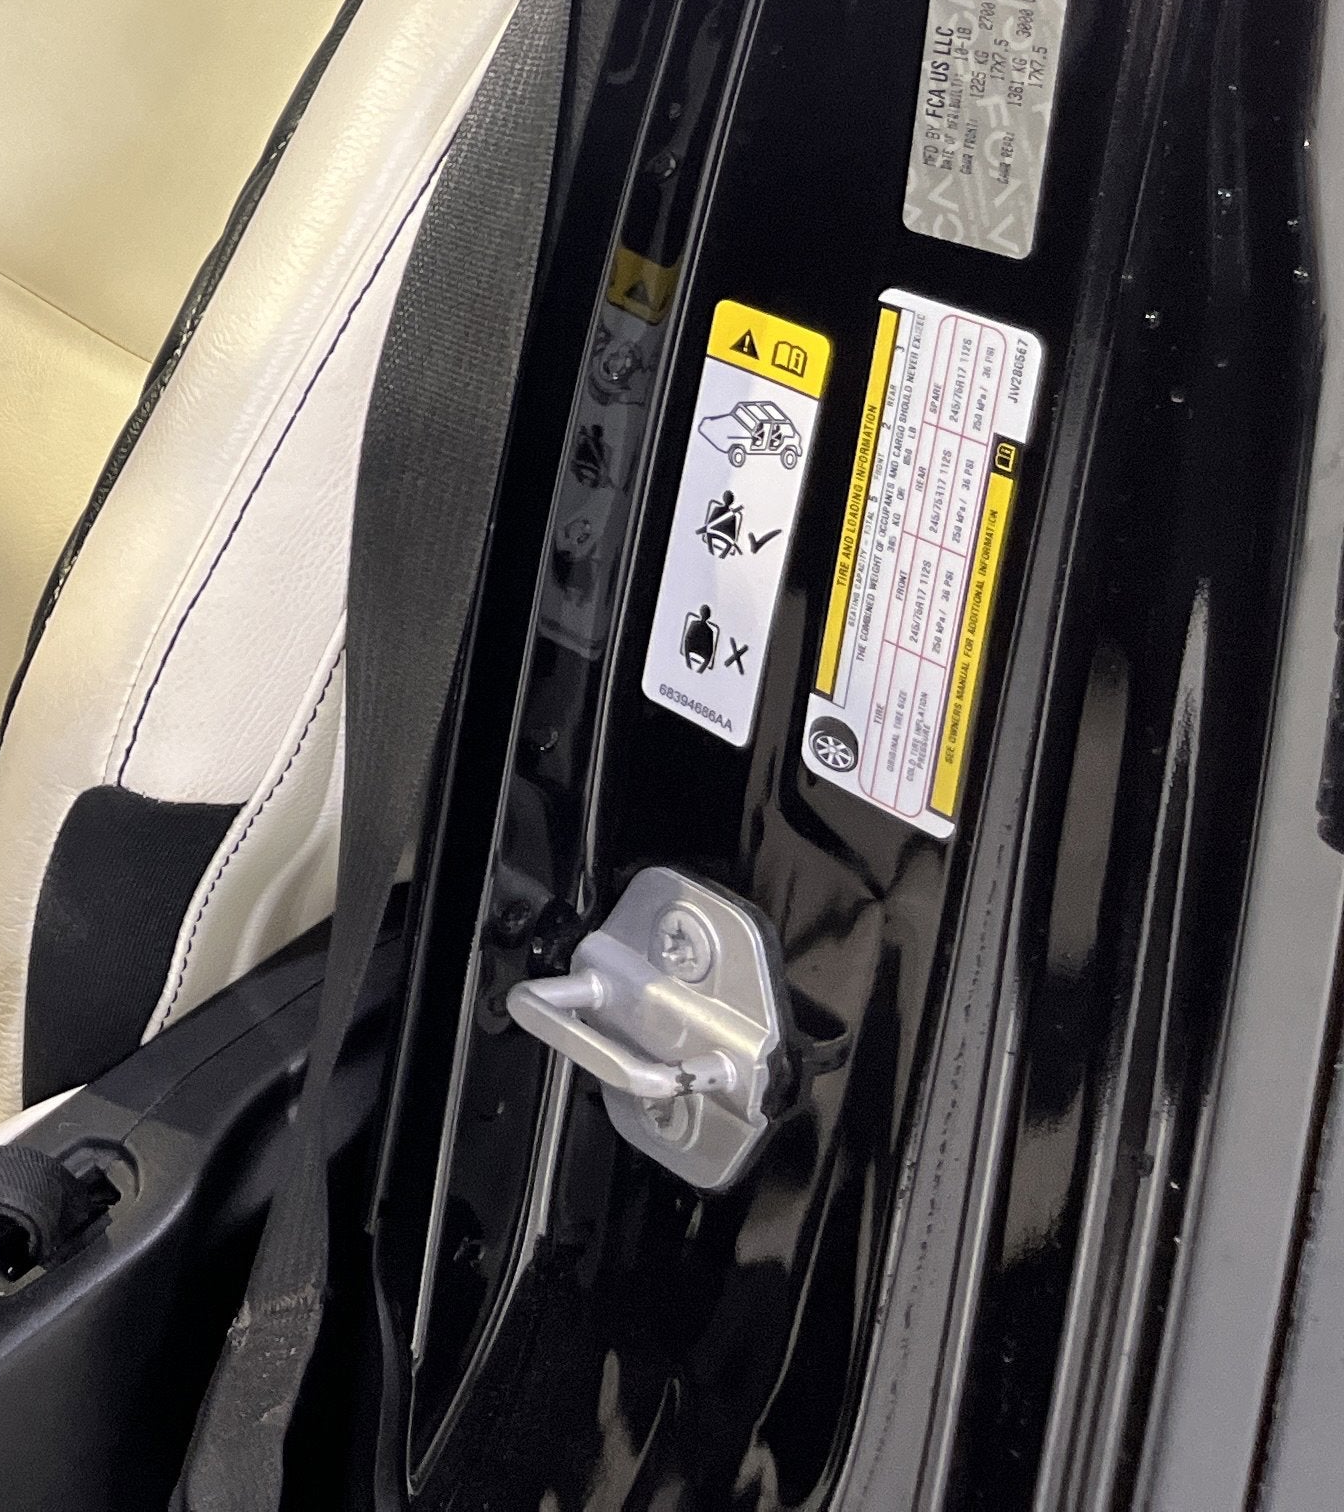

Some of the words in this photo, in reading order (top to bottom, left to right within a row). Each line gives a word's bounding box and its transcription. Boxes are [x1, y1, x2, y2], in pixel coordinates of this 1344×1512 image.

[978, 0, 996, 31] 2700
[1016, 7, 1034, 38] 3000
[933, 24, 954, 56] LLC
[930, 58, 950, 83] US
[974, 49, 989, 65] KG
[989, 37, 1009, 81] 17X7.5
[1012, 55, 1027, 73] KG
[1028, 44, 1048, 89] 17X7.5
[969, 69, 986, 99] 1225
[1007, 78, 1024, 107] 1361
[925, 85, 946, 119] FCA
[926, 123, 940, 139] BY
[944, 132, 956, 145] OF
[923, 143, 938, 167] MFD
[941, 148, 954, 171] DATE
[895, 344, 905, 353] 3
[960, 337, 972, 363] 112S
[985, 345, 995, 364] PSI
[907, 351, 919, 383] NEVER
[982, 364, 992, 378] 36
[1007, 337, 1029, 404] JW280567
[887, 383, 896, 408] REAR
[899, 384, 913, 424] SHOULD
[949, 365, 967, 423] 245/75R17
[881, 421, 891, 430] 2
[973, 412, 983, 431] 250
[855, 402, 877, 482] INFORMATION
[893, 424, 905, 458] CARGO
[875, 452, 885, 481] FRONT
[889, 459, 899, 480] AND
[940, 447, 952, 475] 112S
[964, 458, 974, 476] PSI
[892, 512, 901, 527] KG
[897, 486, 905, 501] OR
[908, 425, 916, 439] LB
[961, 476, 971, 491] 36
[846, 482, 863, 533] LOADING
[868, 492, 878, 503] 5
[879, 481, 895, 538] OCCUPANTS
[929, 477, 946, 534] 245/75R17
[865, 509, 875, 536] TOTAL
[952, 524, 962, 544] 250
[841, 534, 854, 560] AND
[874, 702, 884, 725] TIRE
[895, 568, 908, 602] FRONT
[915, 465, 926, 492] REAR
[929, 381, 941, 414] SPARE
[876, 538, 885, 553] OF
[978, 507, 998, 577] INFORMATION
[837, 560, 849, 589] TIRE
[855, 549, 867, 590] CAPACITY
[869, 553, 882, 591] WEIGHT
[920, 558, 932, 586] 112S
[944, 569, 954, 588] PSI
[849, 590, 860, 628] SEATING
[860, 592, 875, 642] COMBINED
[910, 587, 927, 644] 245/75R17
[968, 577, 985, 636] ADDITIONAL
[857, 642, 866, 663] THE
[932, 634, 942, 654] 250
[963, 636, 974, 659] FOR
[956, 659, 970, 702] MANUAL
[659, 683, 732, 732] 68394686AA
[897, 688, 907, 710] SIZE
[914, 690, 929, 737] INFLATION
[894, 709, 904, 731] TIRE
[948, 701, 962, 744] OWNERS
[887, 731, 900, 773] ORIGINAL
[911, 736, 921, 757] TIRE
[916, 722, 931, 770] PRESSURE
[945, 744, 955, 765] SEE
[907, 756, 917, 783] COLD
